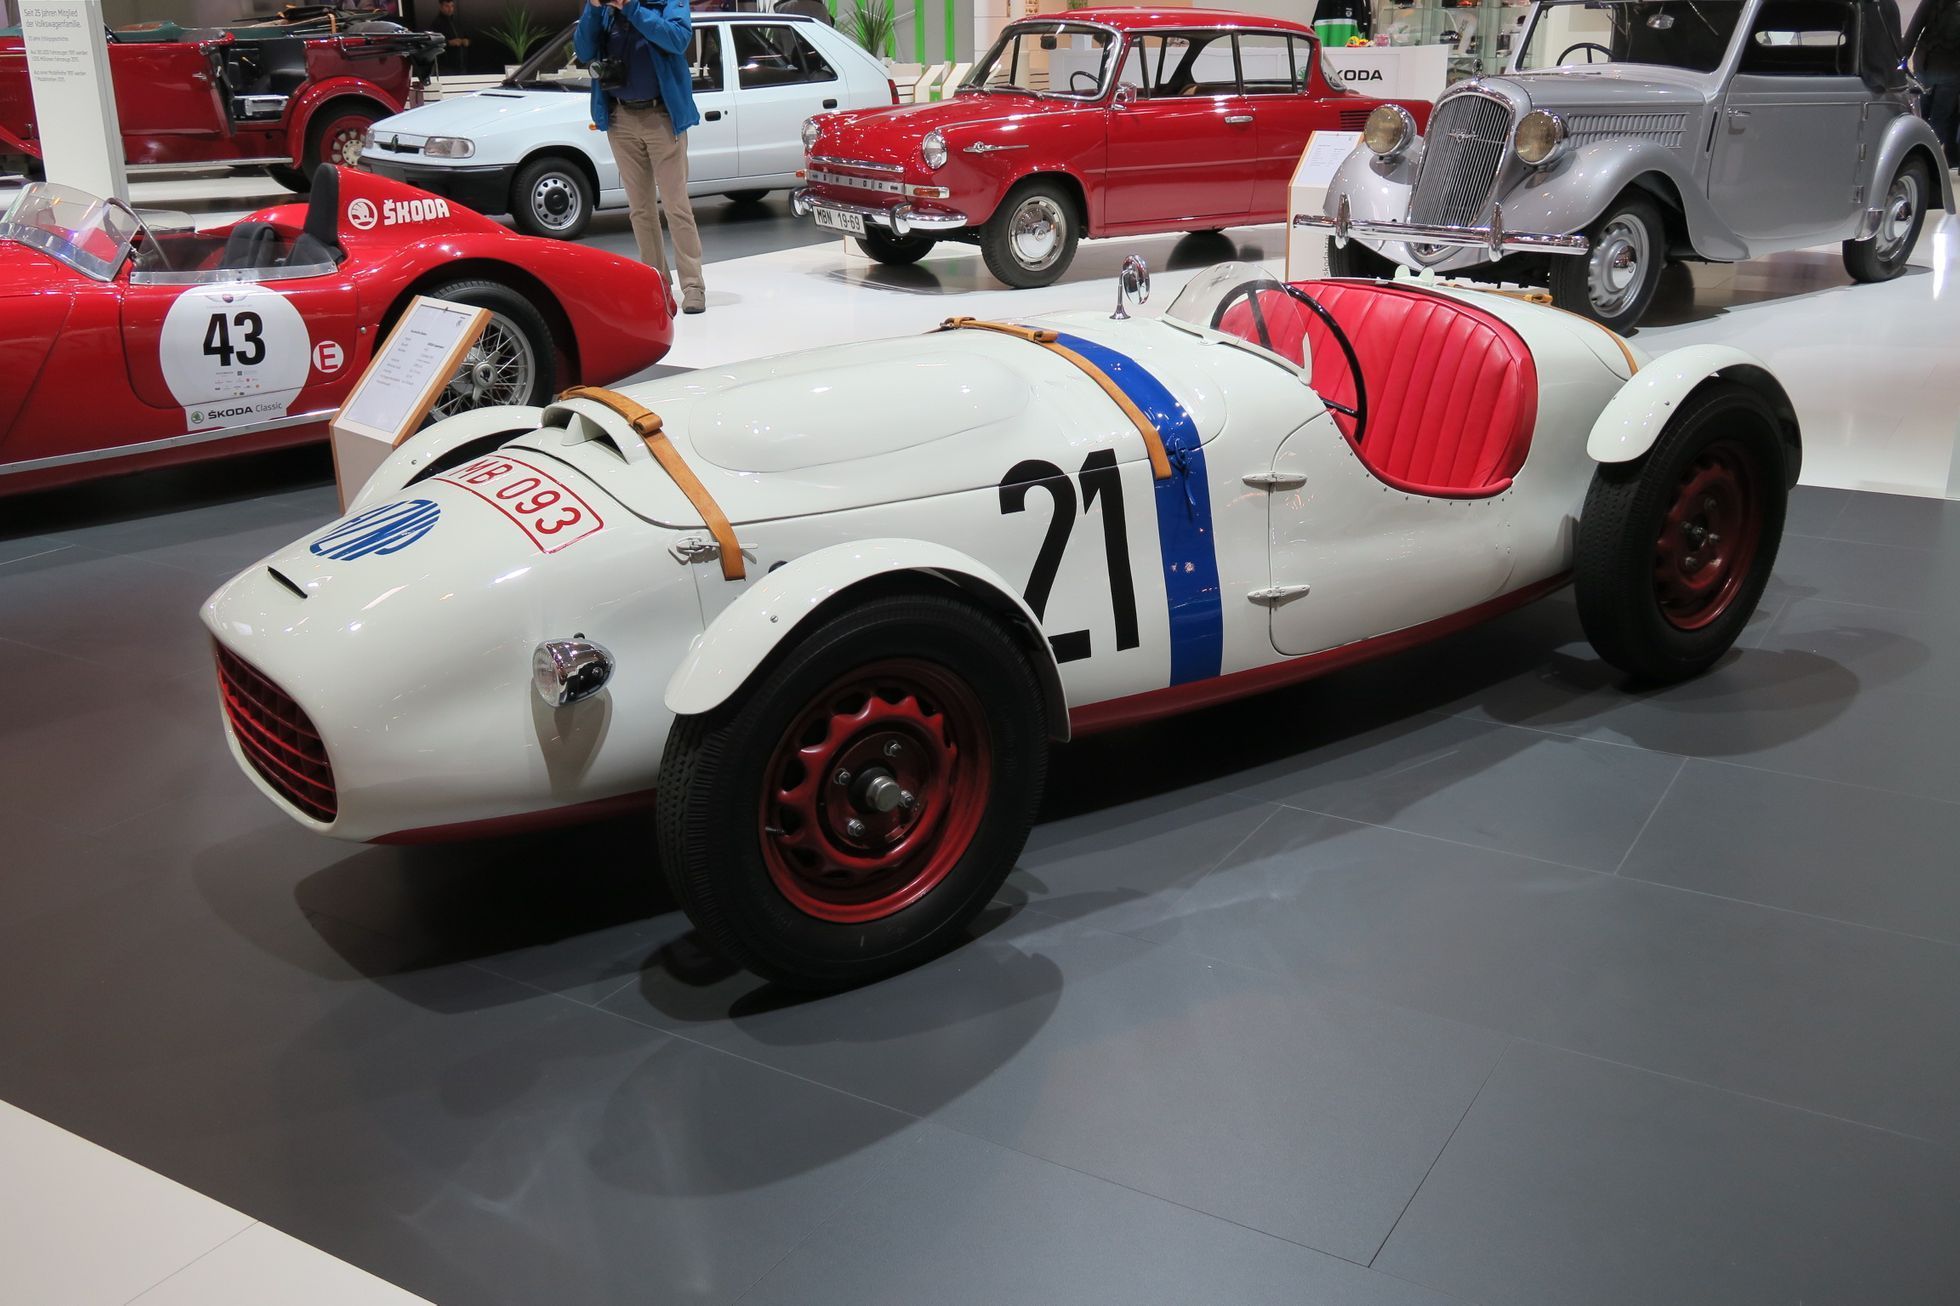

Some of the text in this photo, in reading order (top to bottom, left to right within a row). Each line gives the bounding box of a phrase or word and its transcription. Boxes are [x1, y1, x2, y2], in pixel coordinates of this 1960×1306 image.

[24, 9, 34, 17] Seit
[58, 9, 78, 19] Mitglied
[383, 199, 451, 226] ŠKODA
[816, 208, 833, 225] MBN
[203, 311, 266, 367] 43
[318, 343, 338, 371] E
[208, 401, 283, 420] ŠKODA Classic
[448, 459, 582, 535] MB 093
[998, 448, 1140, 665] 21
